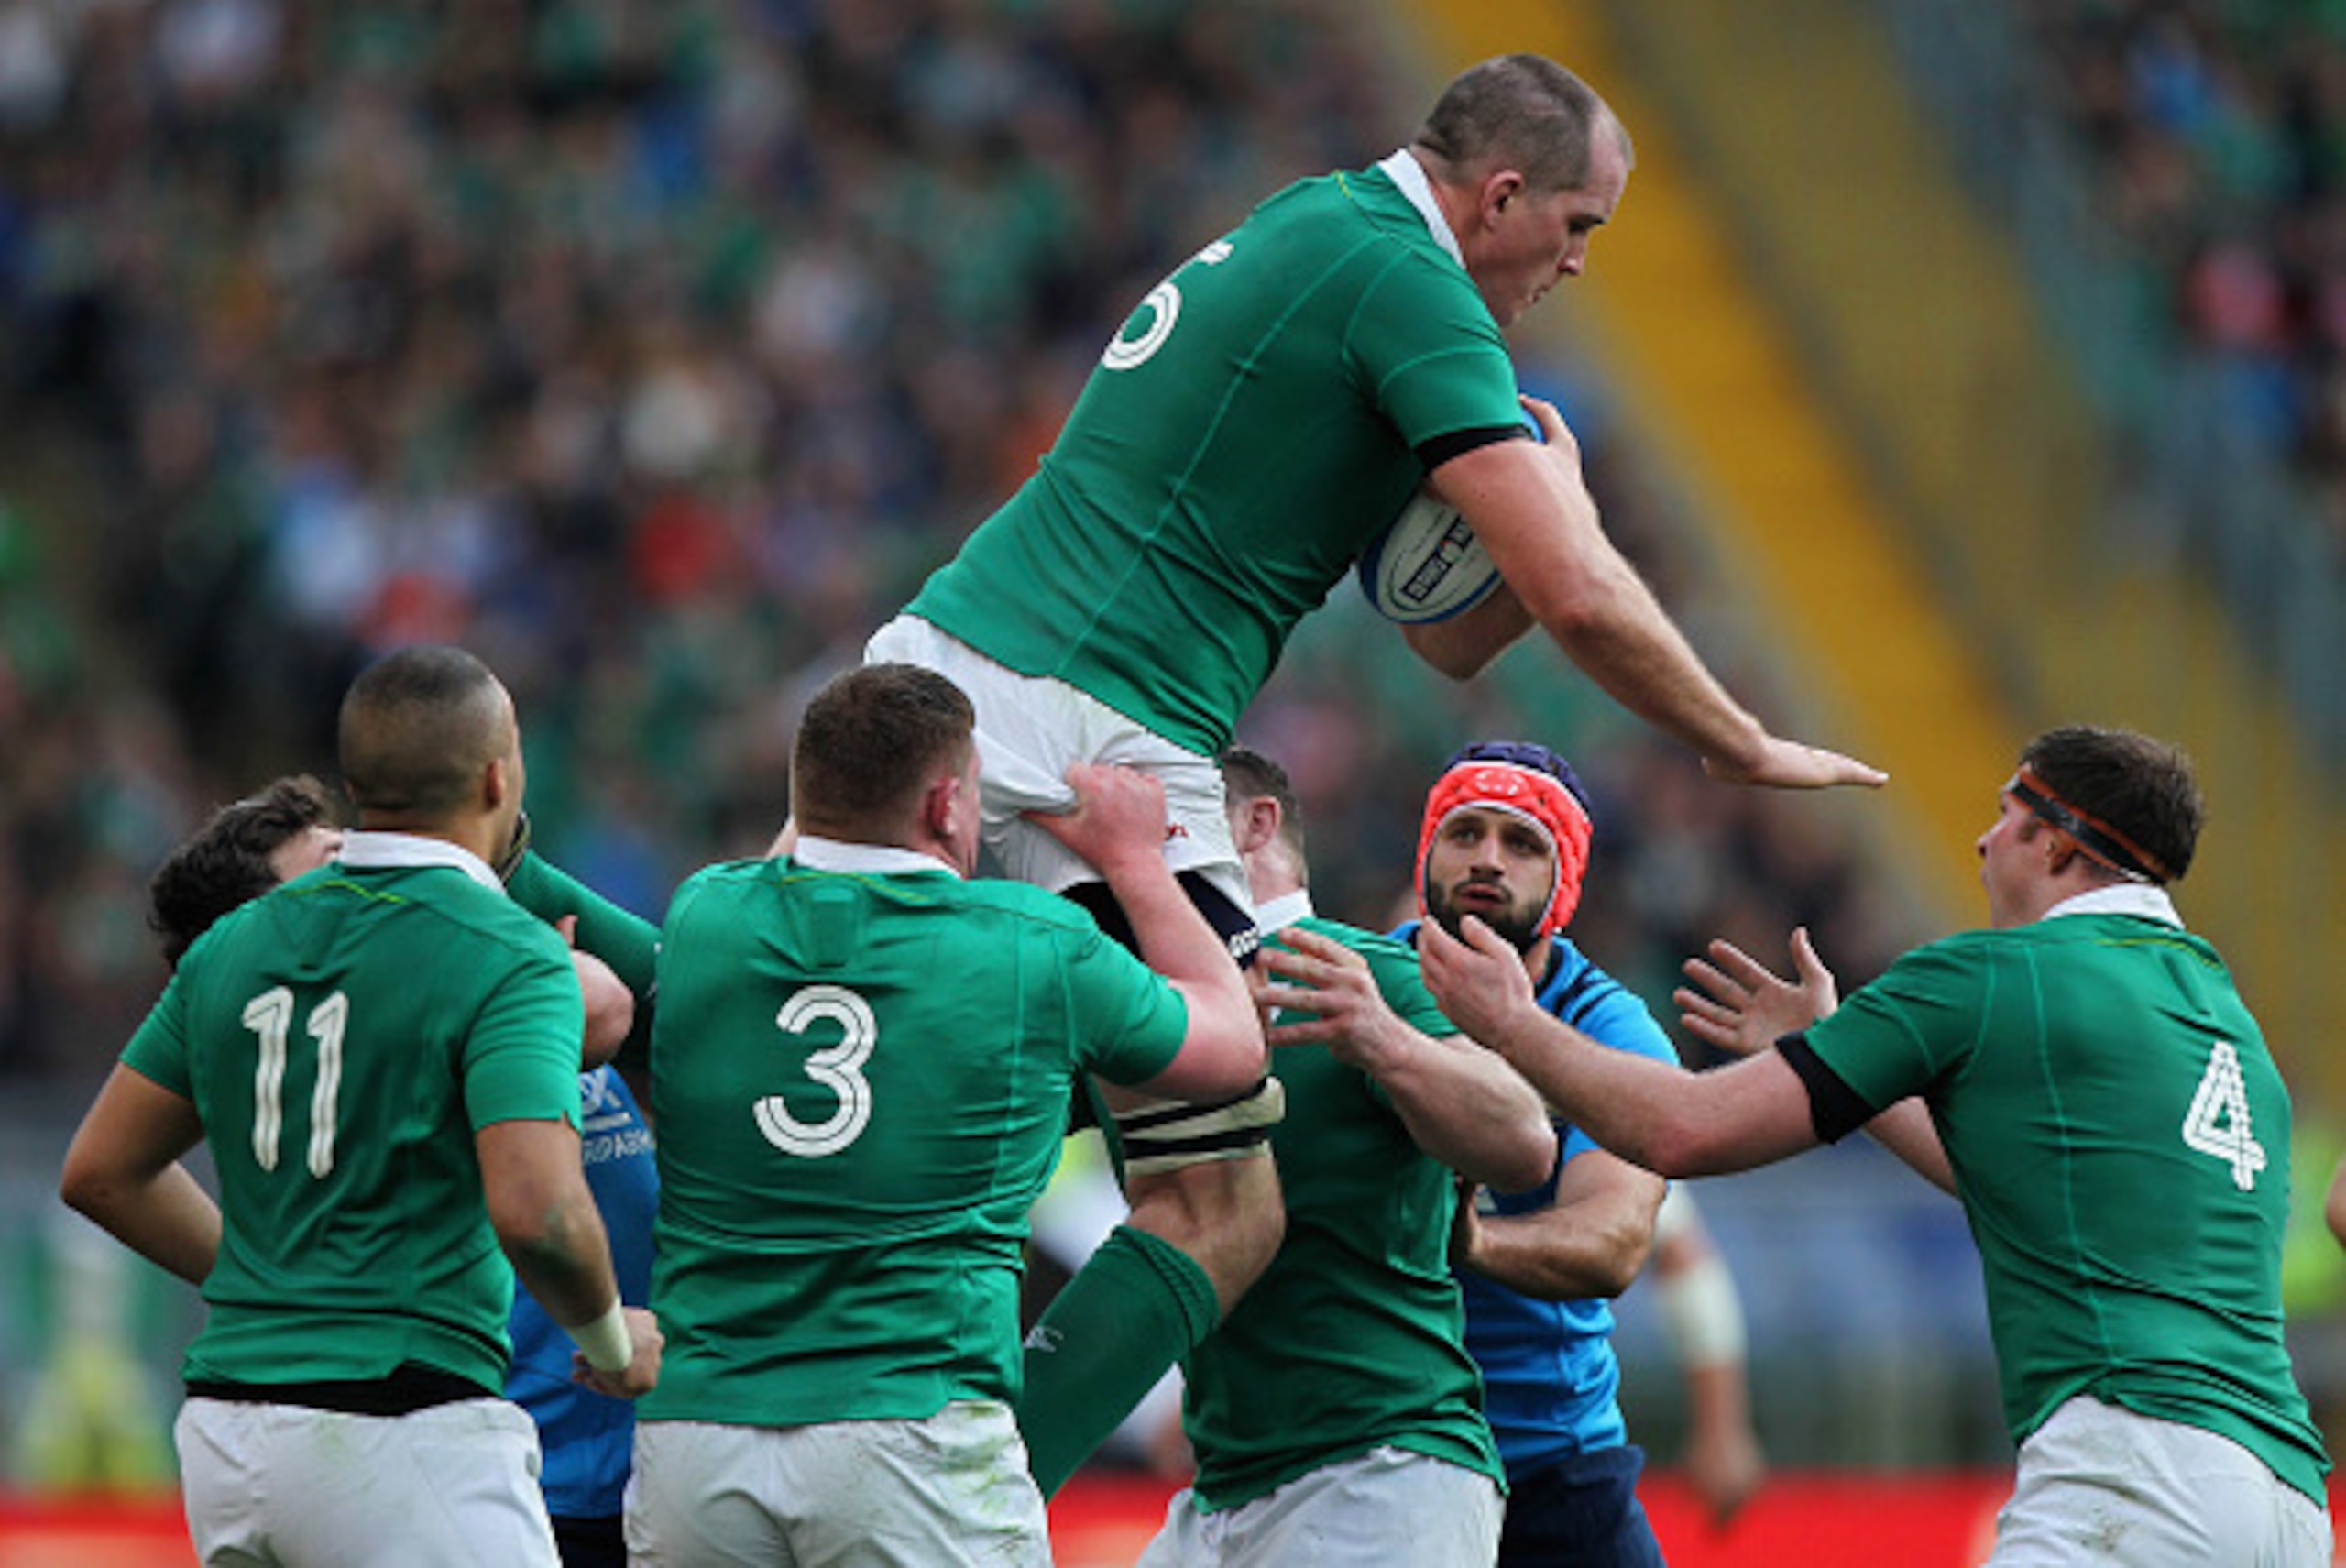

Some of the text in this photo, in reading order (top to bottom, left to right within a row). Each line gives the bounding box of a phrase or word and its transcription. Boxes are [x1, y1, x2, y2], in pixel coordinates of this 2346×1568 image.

[241, 985, 349, 1179] 11
[752, 984, 878, 1157] 3
[2182, 1040, 2267, 1190] 4
